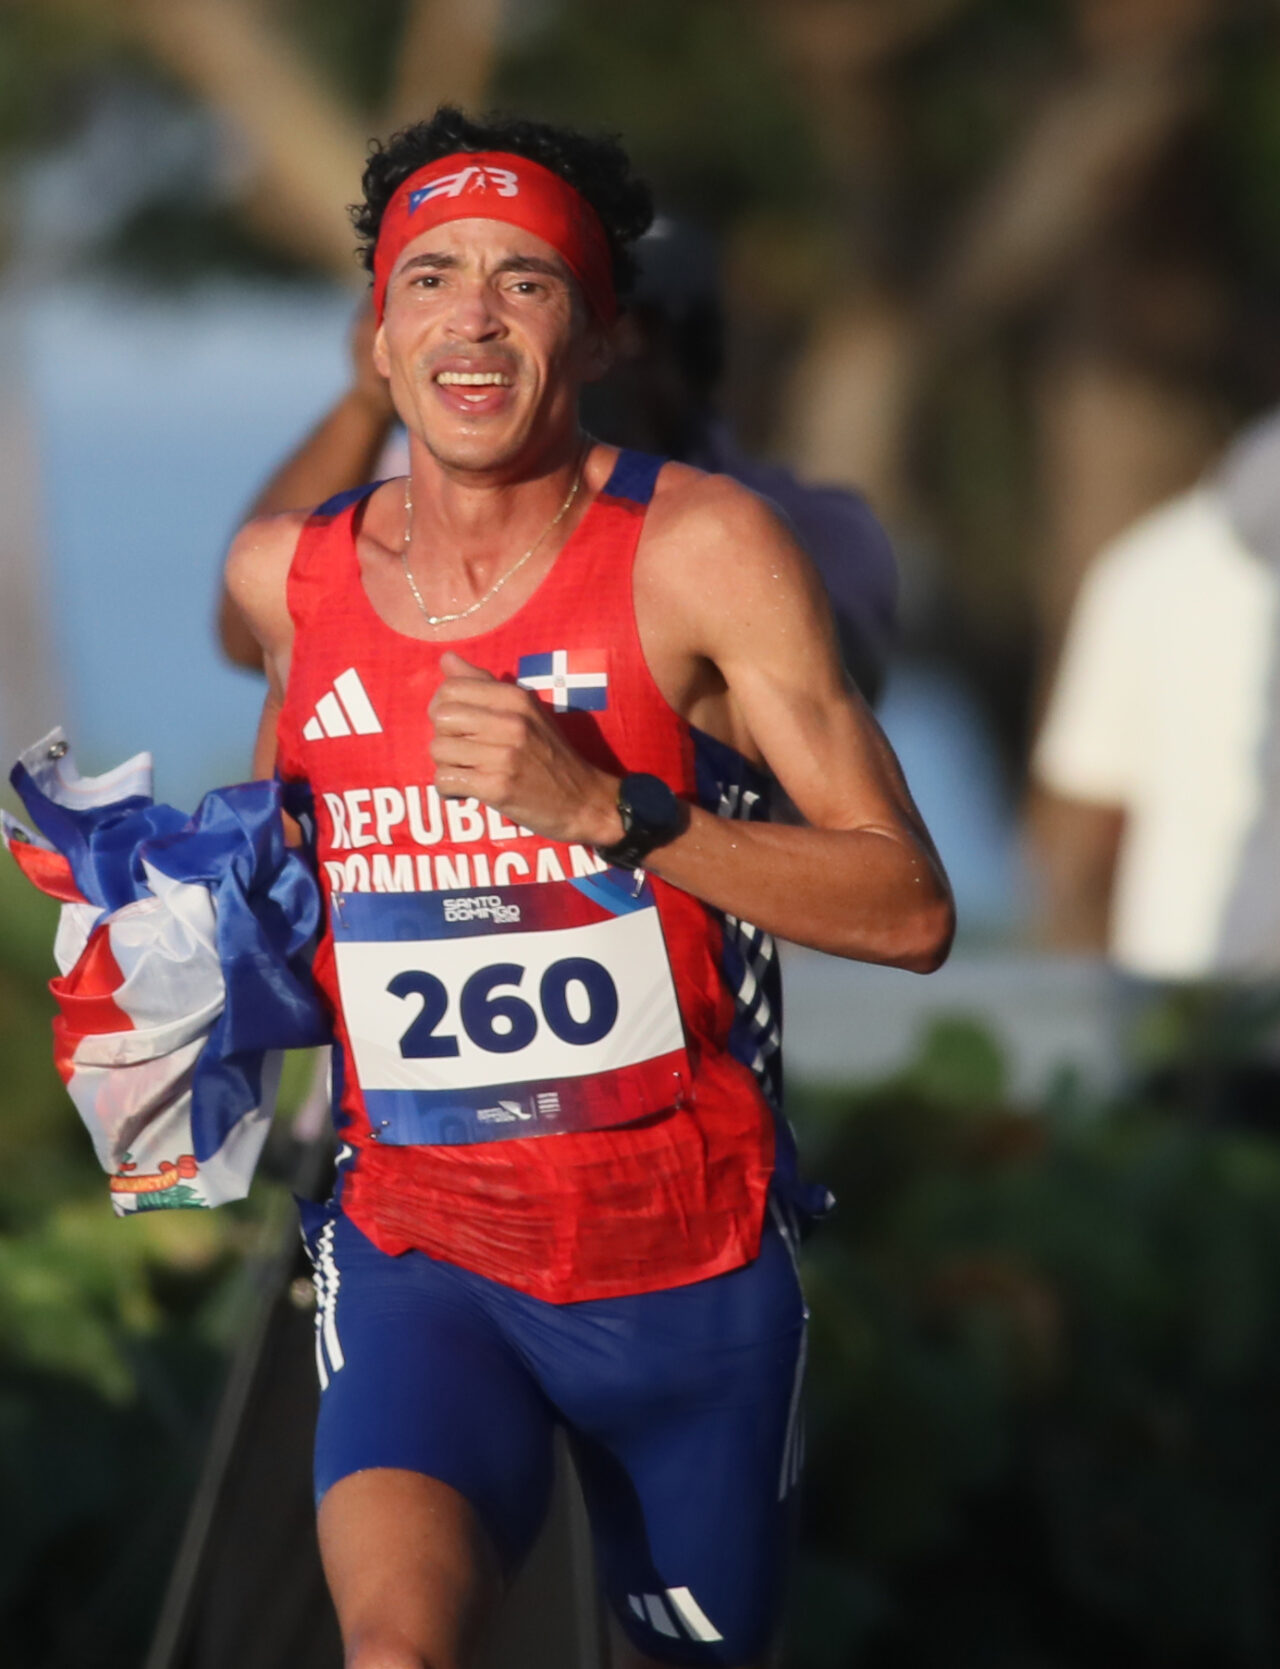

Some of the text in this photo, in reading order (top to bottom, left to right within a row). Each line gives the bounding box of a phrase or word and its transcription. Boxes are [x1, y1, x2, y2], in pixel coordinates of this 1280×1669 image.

[322, 785, 534, 849] REPUBL
[443, 896, 501, 911] SANTO
[445, 905, 520, 922] DOMINGO
[386, 957, 618, 1059] 260
